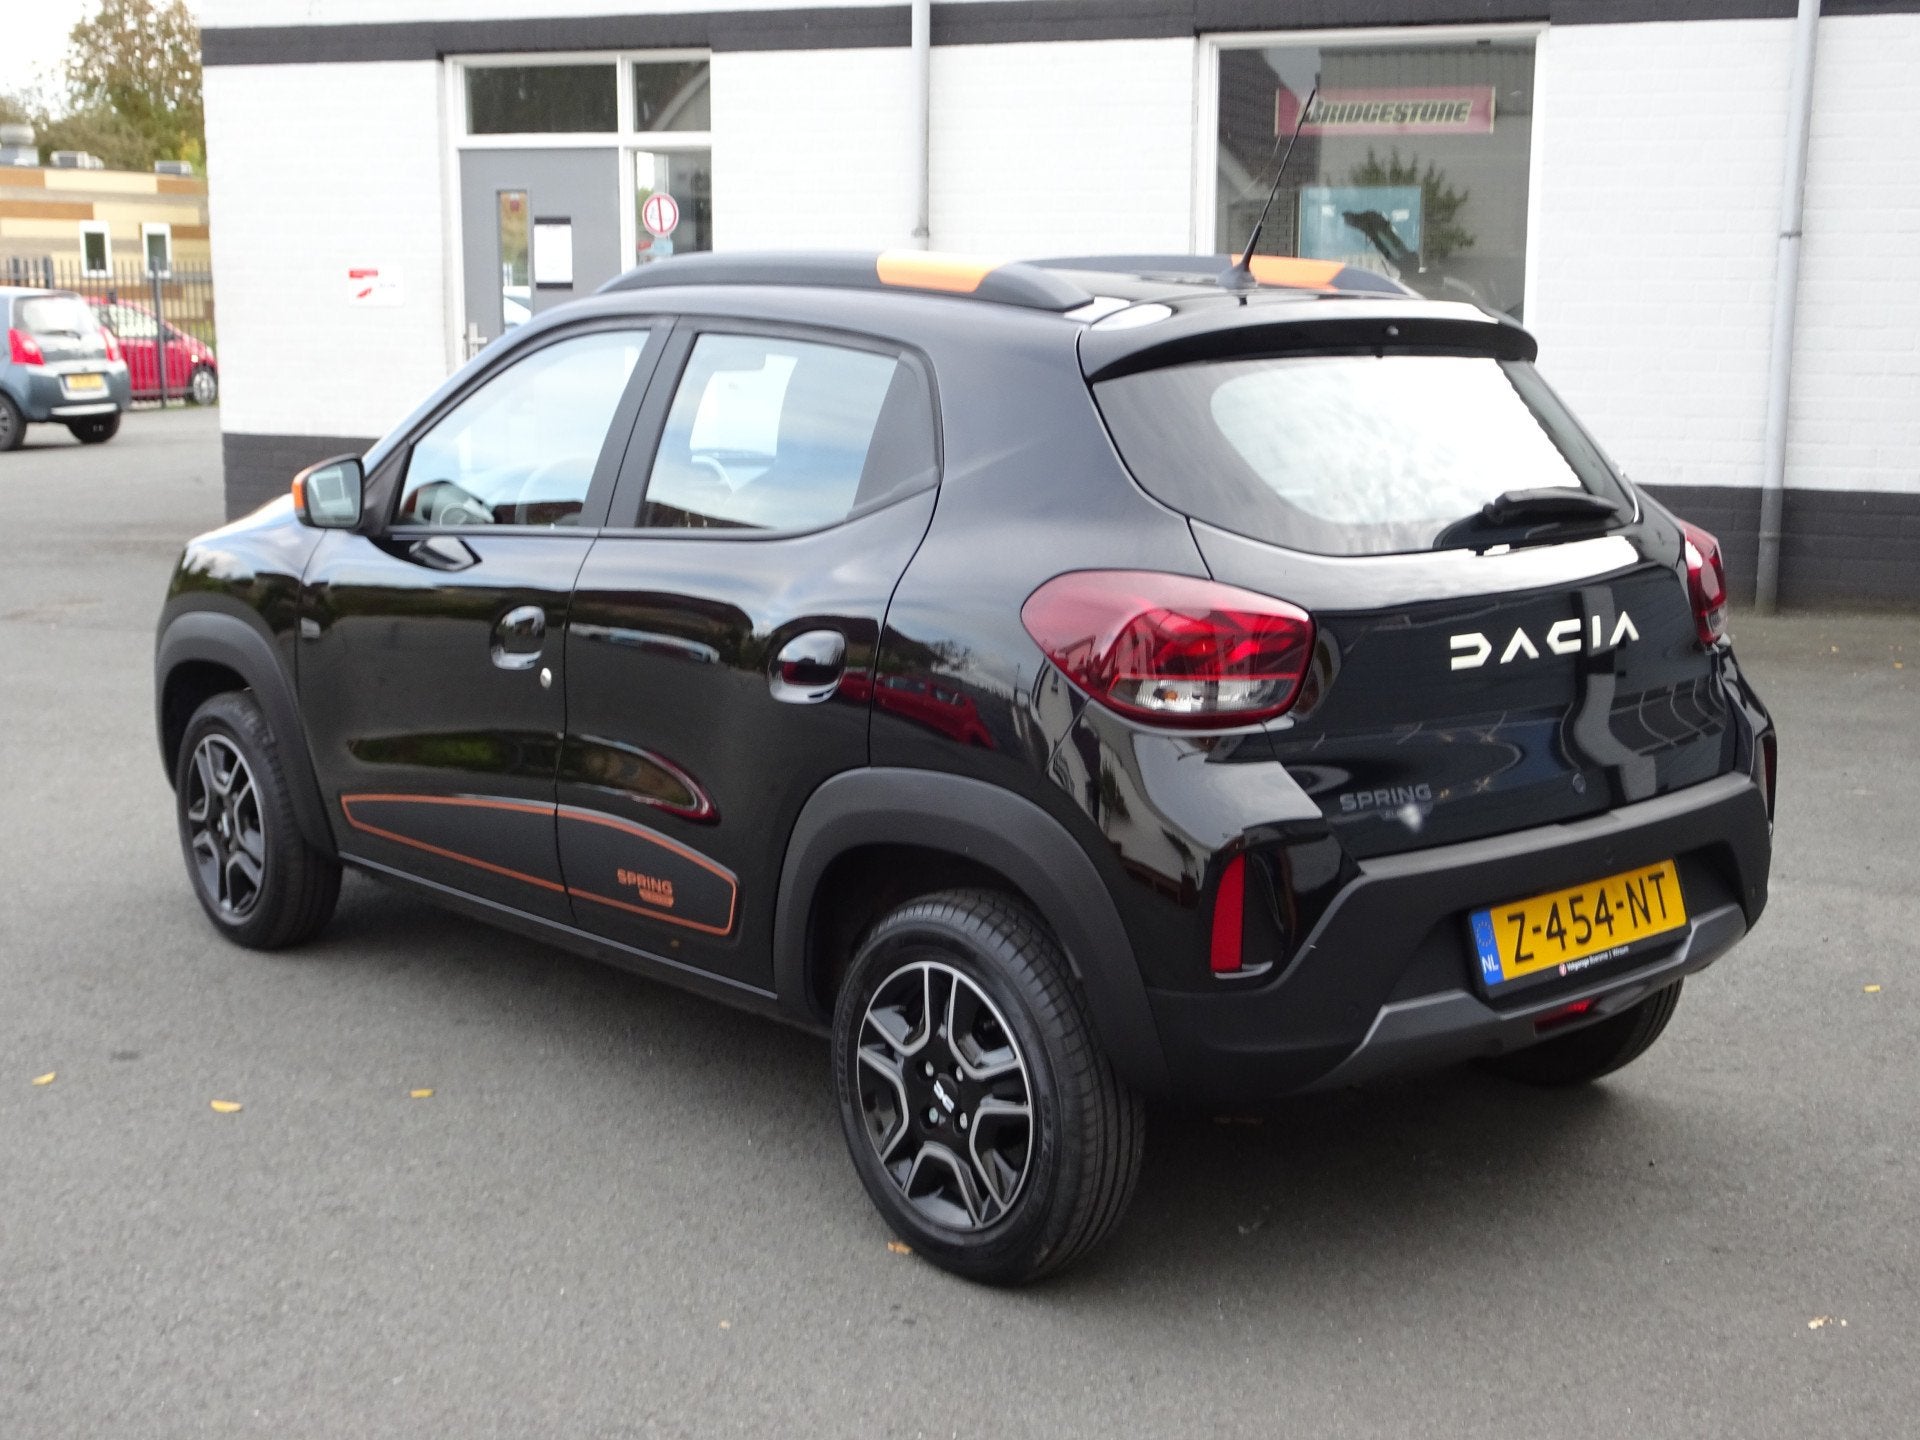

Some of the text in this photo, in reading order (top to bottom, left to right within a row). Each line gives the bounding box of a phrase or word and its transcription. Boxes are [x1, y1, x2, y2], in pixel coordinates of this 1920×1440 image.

[1296, 99, 1473, 126] BRIDGESTONE
[1450, 611, 1640, 671] DACIA
[1340, 783, 1432, 811] SPRING
[617, 868, 673, 897] SPRING
[1507, 871, 1667, 964] Z-454-NT
[1481, 954, 1499, 974] NL
